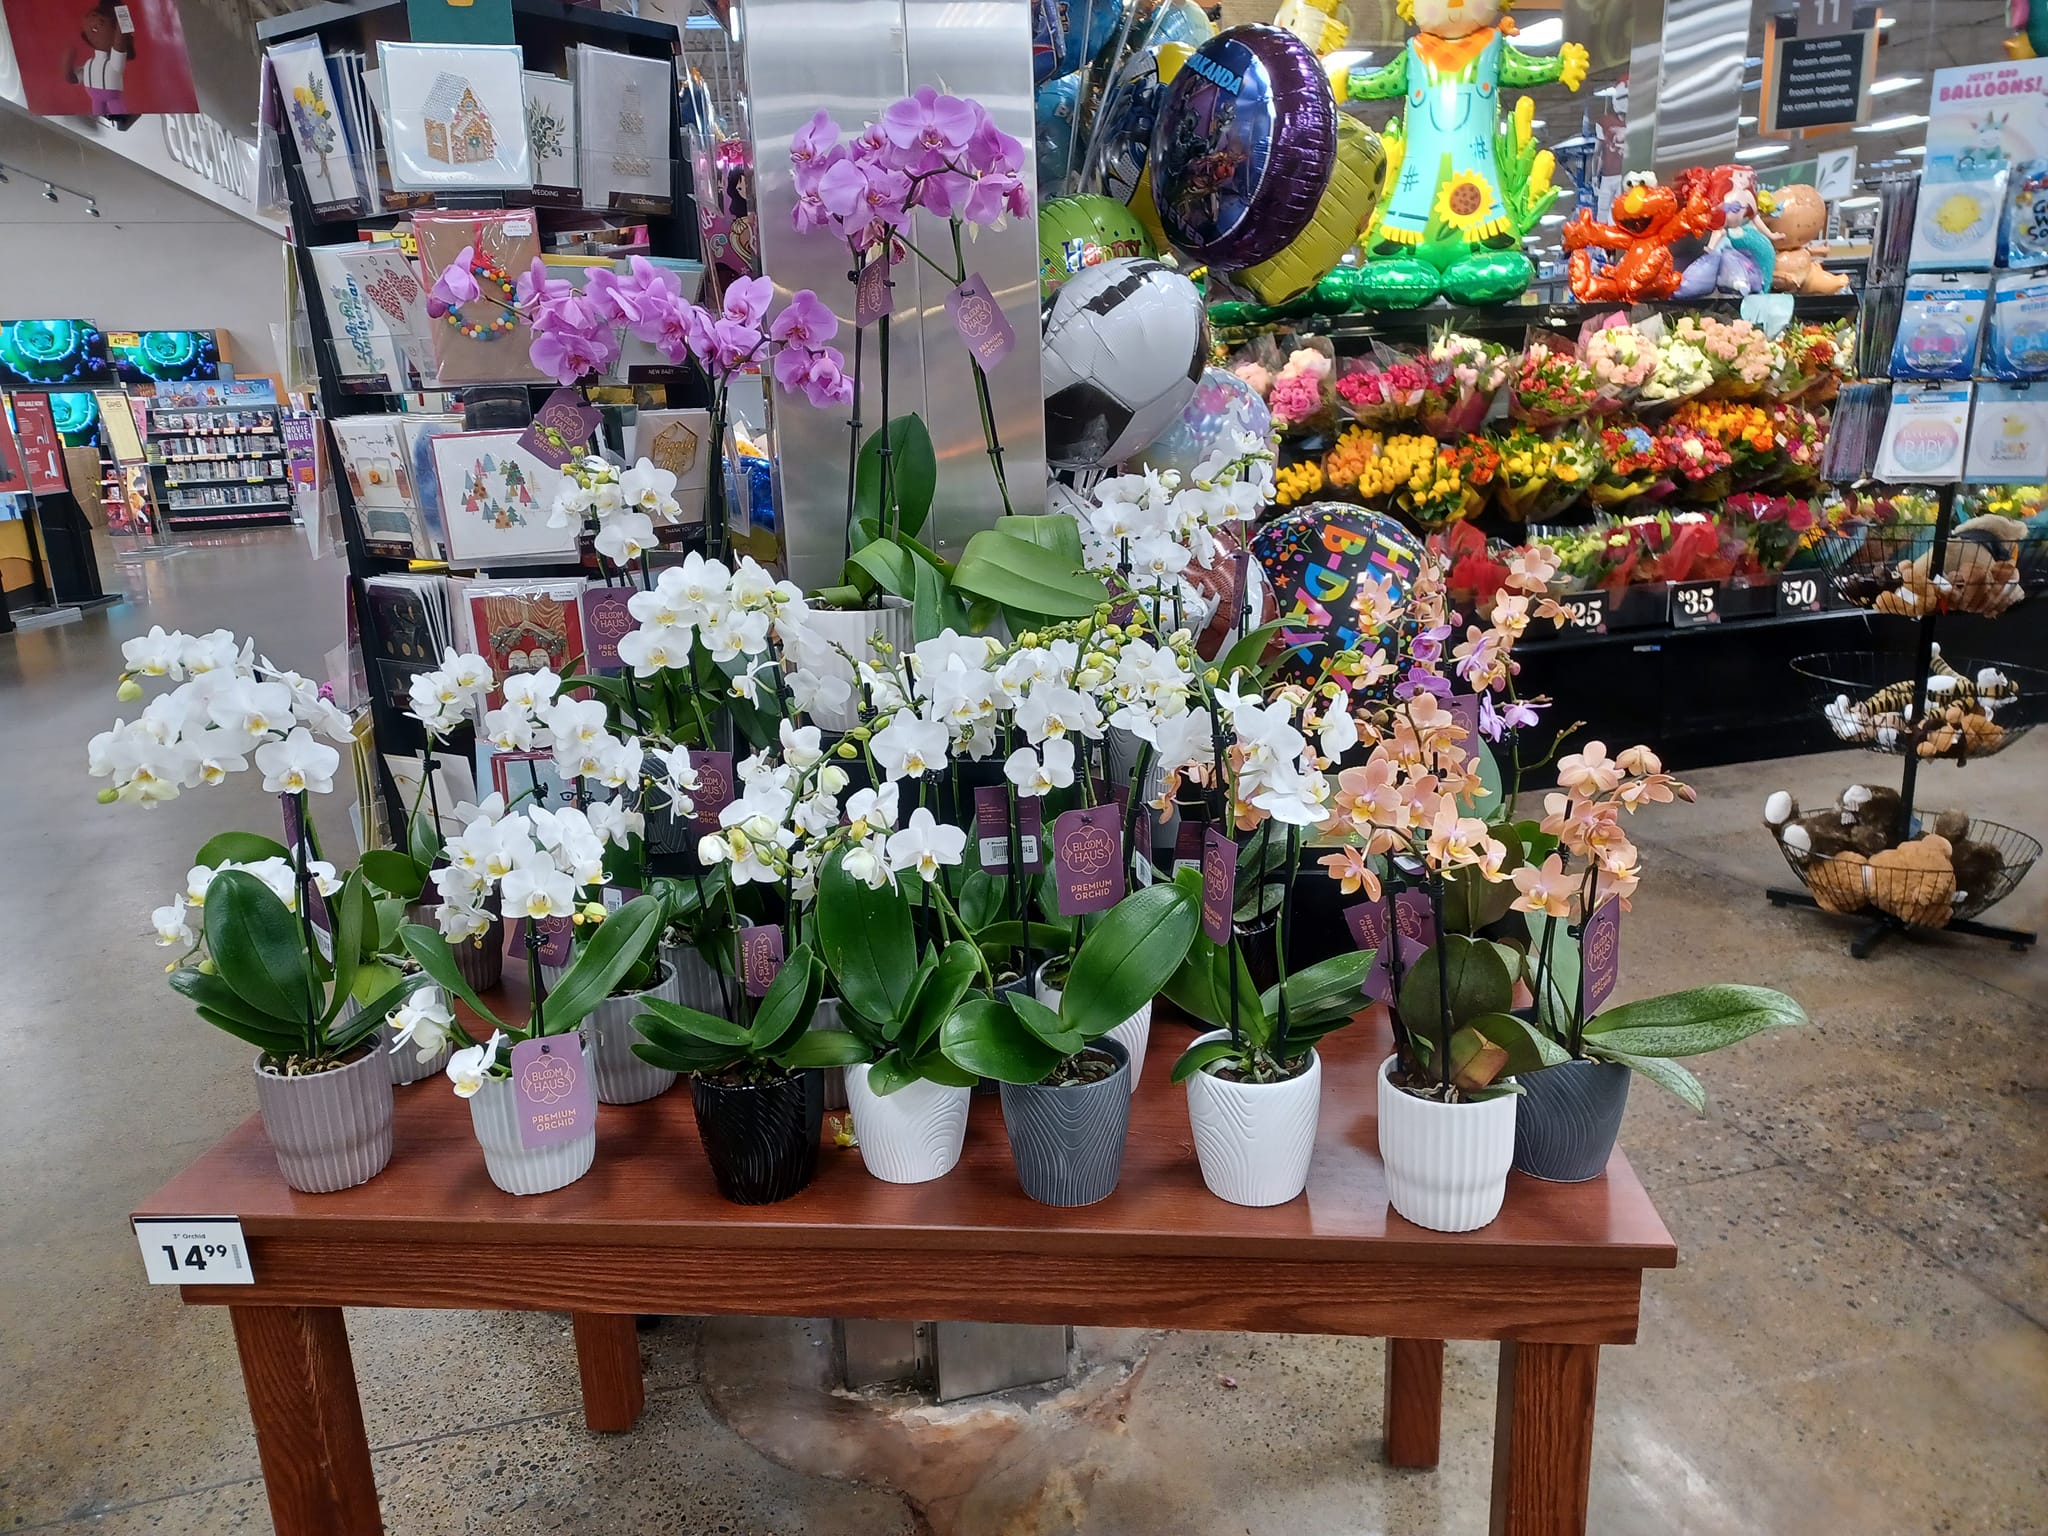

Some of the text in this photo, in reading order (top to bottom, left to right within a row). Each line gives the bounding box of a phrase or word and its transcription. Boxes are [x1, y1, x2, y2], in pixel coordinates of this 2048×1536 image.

[1814, 0, 1840, 25] 11
[1967, 68, 2019, 82] JUST ADD
[1939, 76, 2043, 102] BALLOONS!
[532, 188, 559, 198] WEDDING
[1062, 238, 1142, 274] Happy
[962, 304, 981, 323] BLOOM
[967, 311, 987, 330] HAUS
[978, 330, 1002, 352] PREMIUM
[984, 338, 1004, 357] ORCHID
[552, 416, 574, 436] HAUS
[556, 410, 578, 430] BLOOM
[286, 425, 310, 434] MOVIE
[288, 432, 312, 441] NIGHT?
[534, 440, 559, 460] ORCHID
[1904, 439, 1944, 464] BABY
[1678, 587, 1715, 614] $35
[1782, 579, 1817, 606] $50
[599, 611, 624, 620] BLOOM
[600, 620, 624, 628] HAUS
[1072, 838, 1104, 852] BLOOM
[1074, 850, 1105, 864] HAUS
[1071, 879, 1112, 893] PREMIUM
[1075, 888, 1110, 900] ORCHID
[1398, 908, 1414, 935] BLOOM
[532, 1067, 564, 1081] BLOOM
[534, 1078, 564, 1092] HAUS
[532, 1108, 576, 1124] PREMIUM
[536, 1118, 574, 1132] ORCHID
